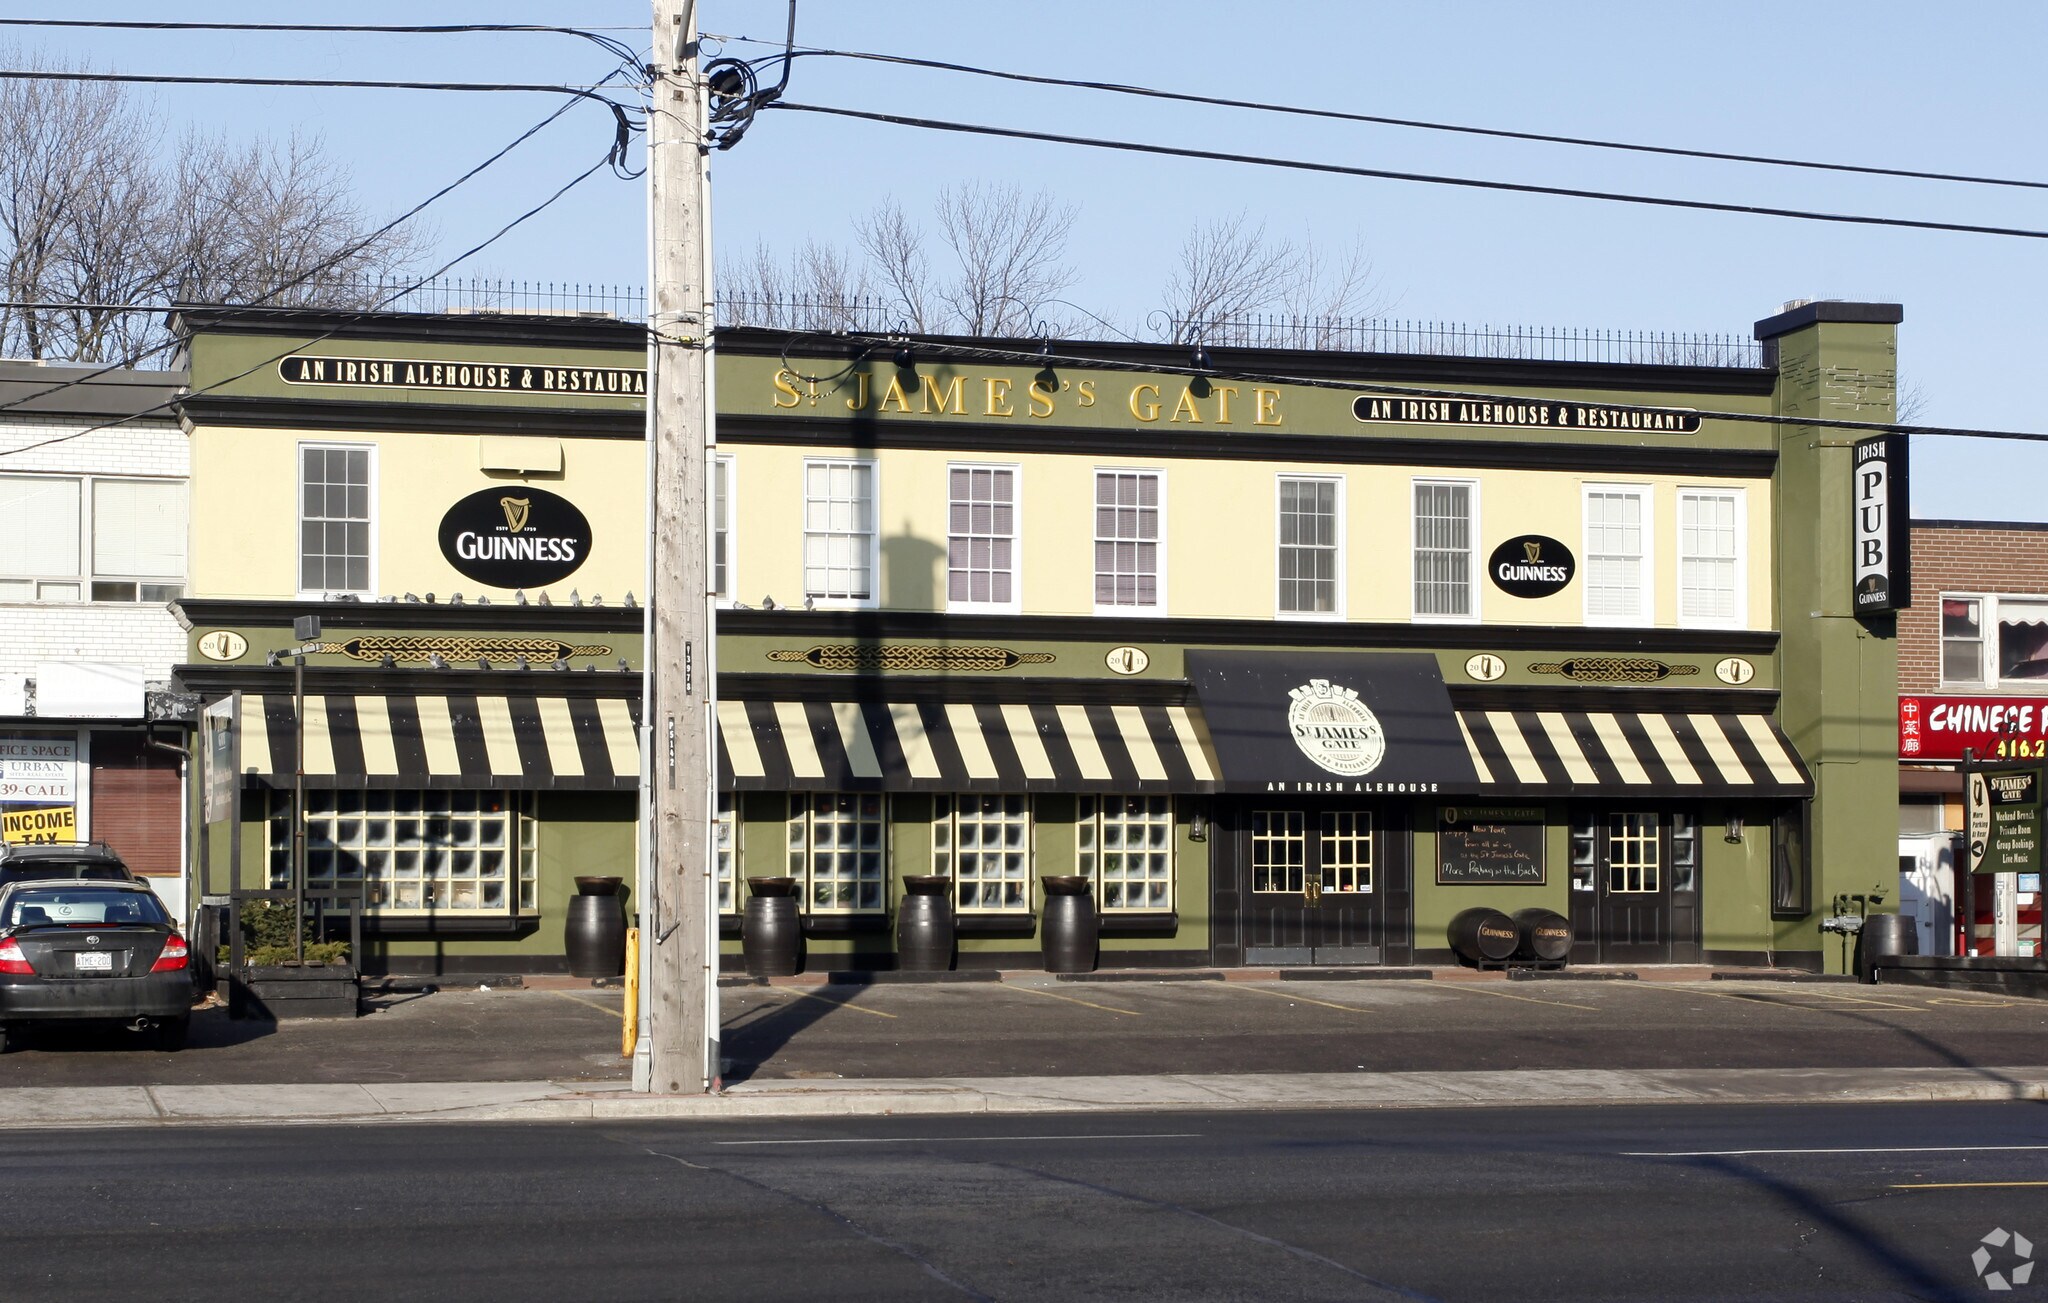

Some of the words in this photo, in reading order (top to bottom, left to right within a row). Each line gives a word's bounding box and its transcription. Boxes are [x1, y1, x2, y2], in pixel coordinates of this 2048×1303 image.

[300, 360, 325, 380] AN
[336, 362, 394, 383] IRISH
[405, 364, 510, 388] ALEHOUSE
[521, 369, 532, 389] &
[544, 369, 644, 393] RESTAURA
[1128, 384, 1284, 427] GATE
[1370, 400, 1391, 419] AN
[1401, 401, 1450, 421] IRISH
[1459, 403, 1549, 425] ALEHOUSE
[1558, 407, 1568, 426] &
[1577, 407, 1685, 430] RESTAURANT
[1858, 441, 1886, 463] IRISH
[1860, 471, 1884, 568] PUB
[456, 531, 576, 562] GUINNESS
[1498, 563, 1567, 581] GUINNESS
[1858, 590, 1887, 605] GUINNESS
[203, 641, 215, 650] 20
[1929, 703, 2034, 734] CHINESE
[1903, 702, 1919, 753] 中菜廊
[31, 745, 71, 756] SPACE
[1322, 740, 1361, 749] GATE
[11, 761, 64, 772] URBAN
[0, 783, 69, 796] 39-CALL
[1267, 782, 1285, 791] AN
[1297, 782, 1343, 792] IRISH
[1355, 782, 1438, 793] ALEHOUSE
[2002, 790, 2022, 800] GATE
[3, 811, 74, 833] INCOME
[2018, 826, 2031, 835] Room
[22, 832, 58, 845] TAX
[2014, 853, 2028, 863] Music
[1481, 926, 1514, 938] GUINNESS
[1535, 927, 1568, 937] GUINNESS
